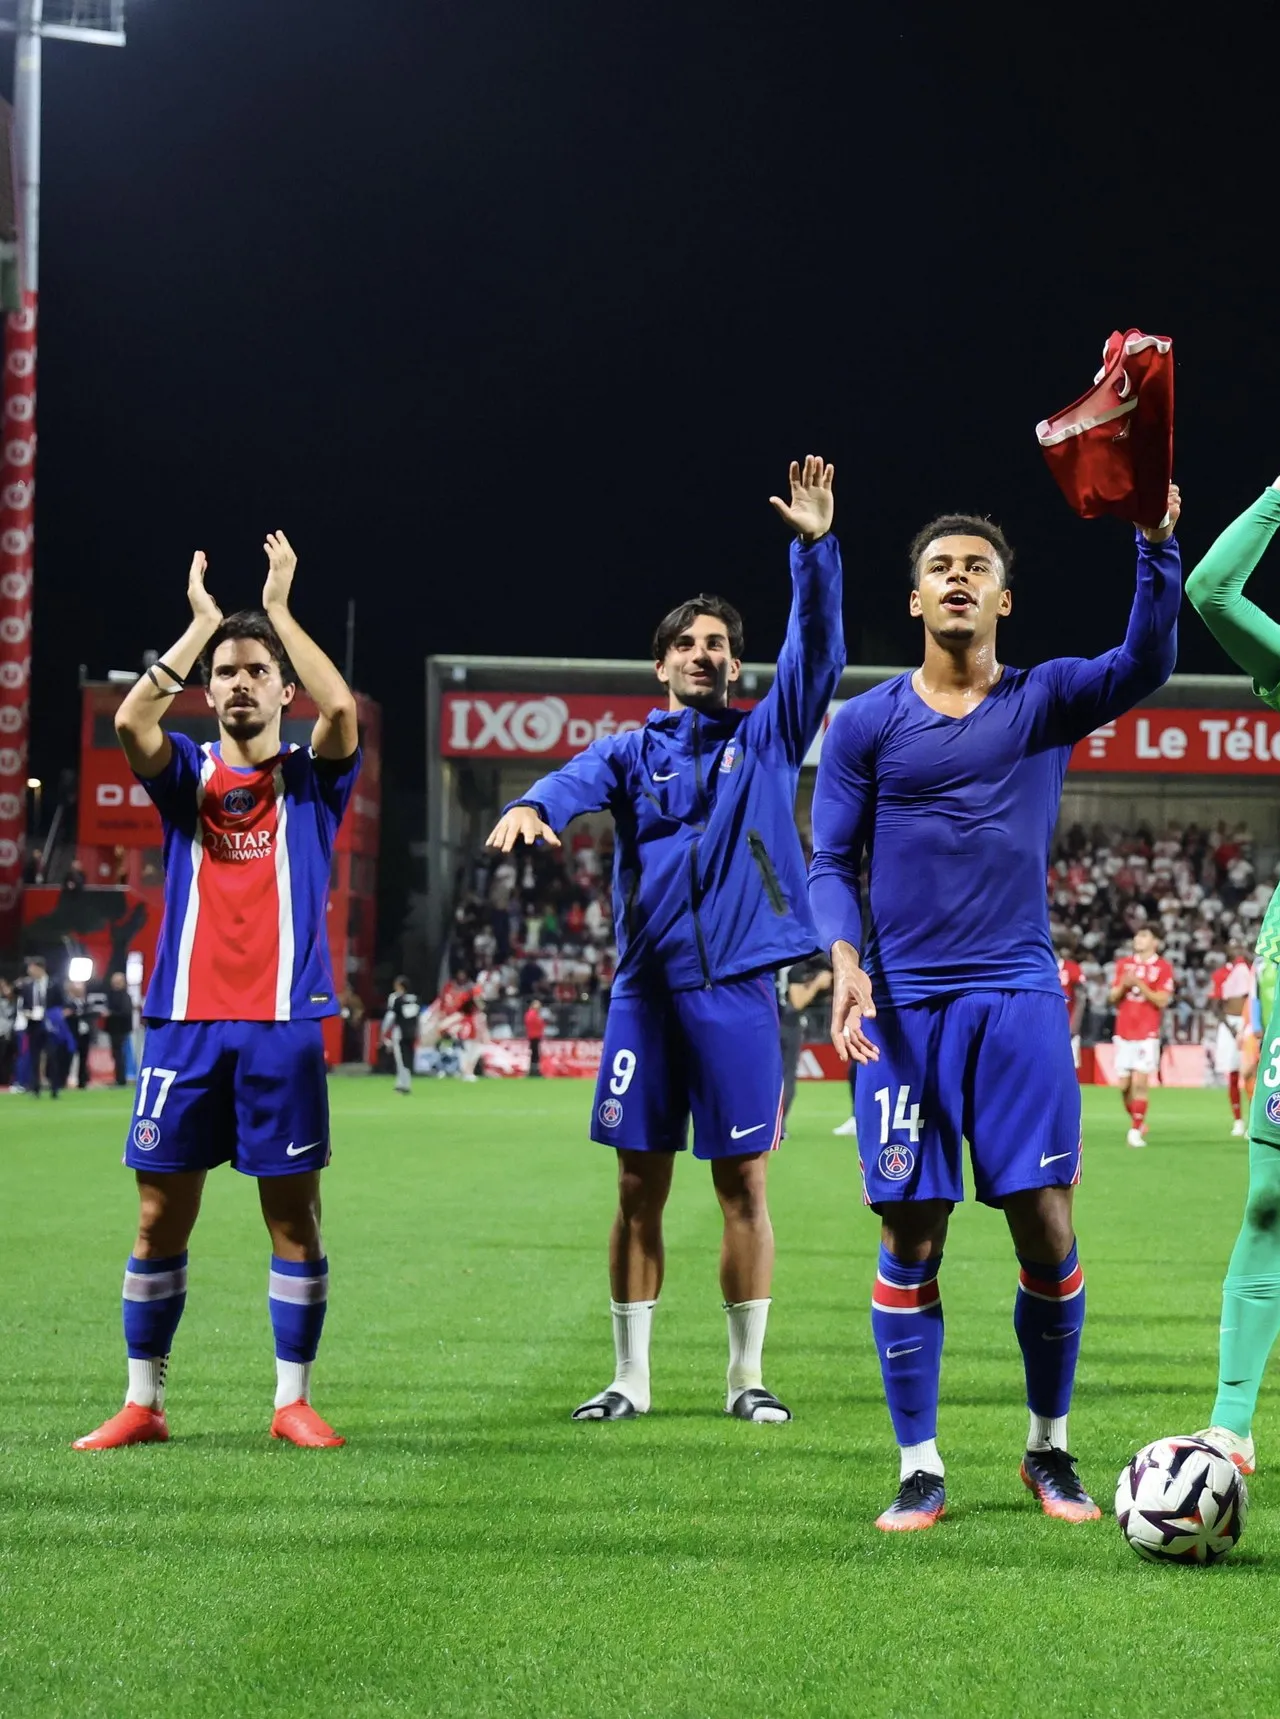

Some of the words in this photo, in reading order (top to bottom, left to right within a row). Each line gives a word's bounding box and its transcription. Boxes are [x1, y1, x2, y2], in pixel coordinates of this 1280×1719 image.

[450, 696, 568, 752] IXO
[1136, 718, 1188, 759] Le
[205, 830, 272, 852] QATAR
[220, 847, 272, 861] AIRWAYS
[136, 1066, 177, 1118] 17
[609, 1049, 636, 1095] 9
[874, 1085, 925, 1144] 14
[884, 1146, 908, 1156] PARIS
